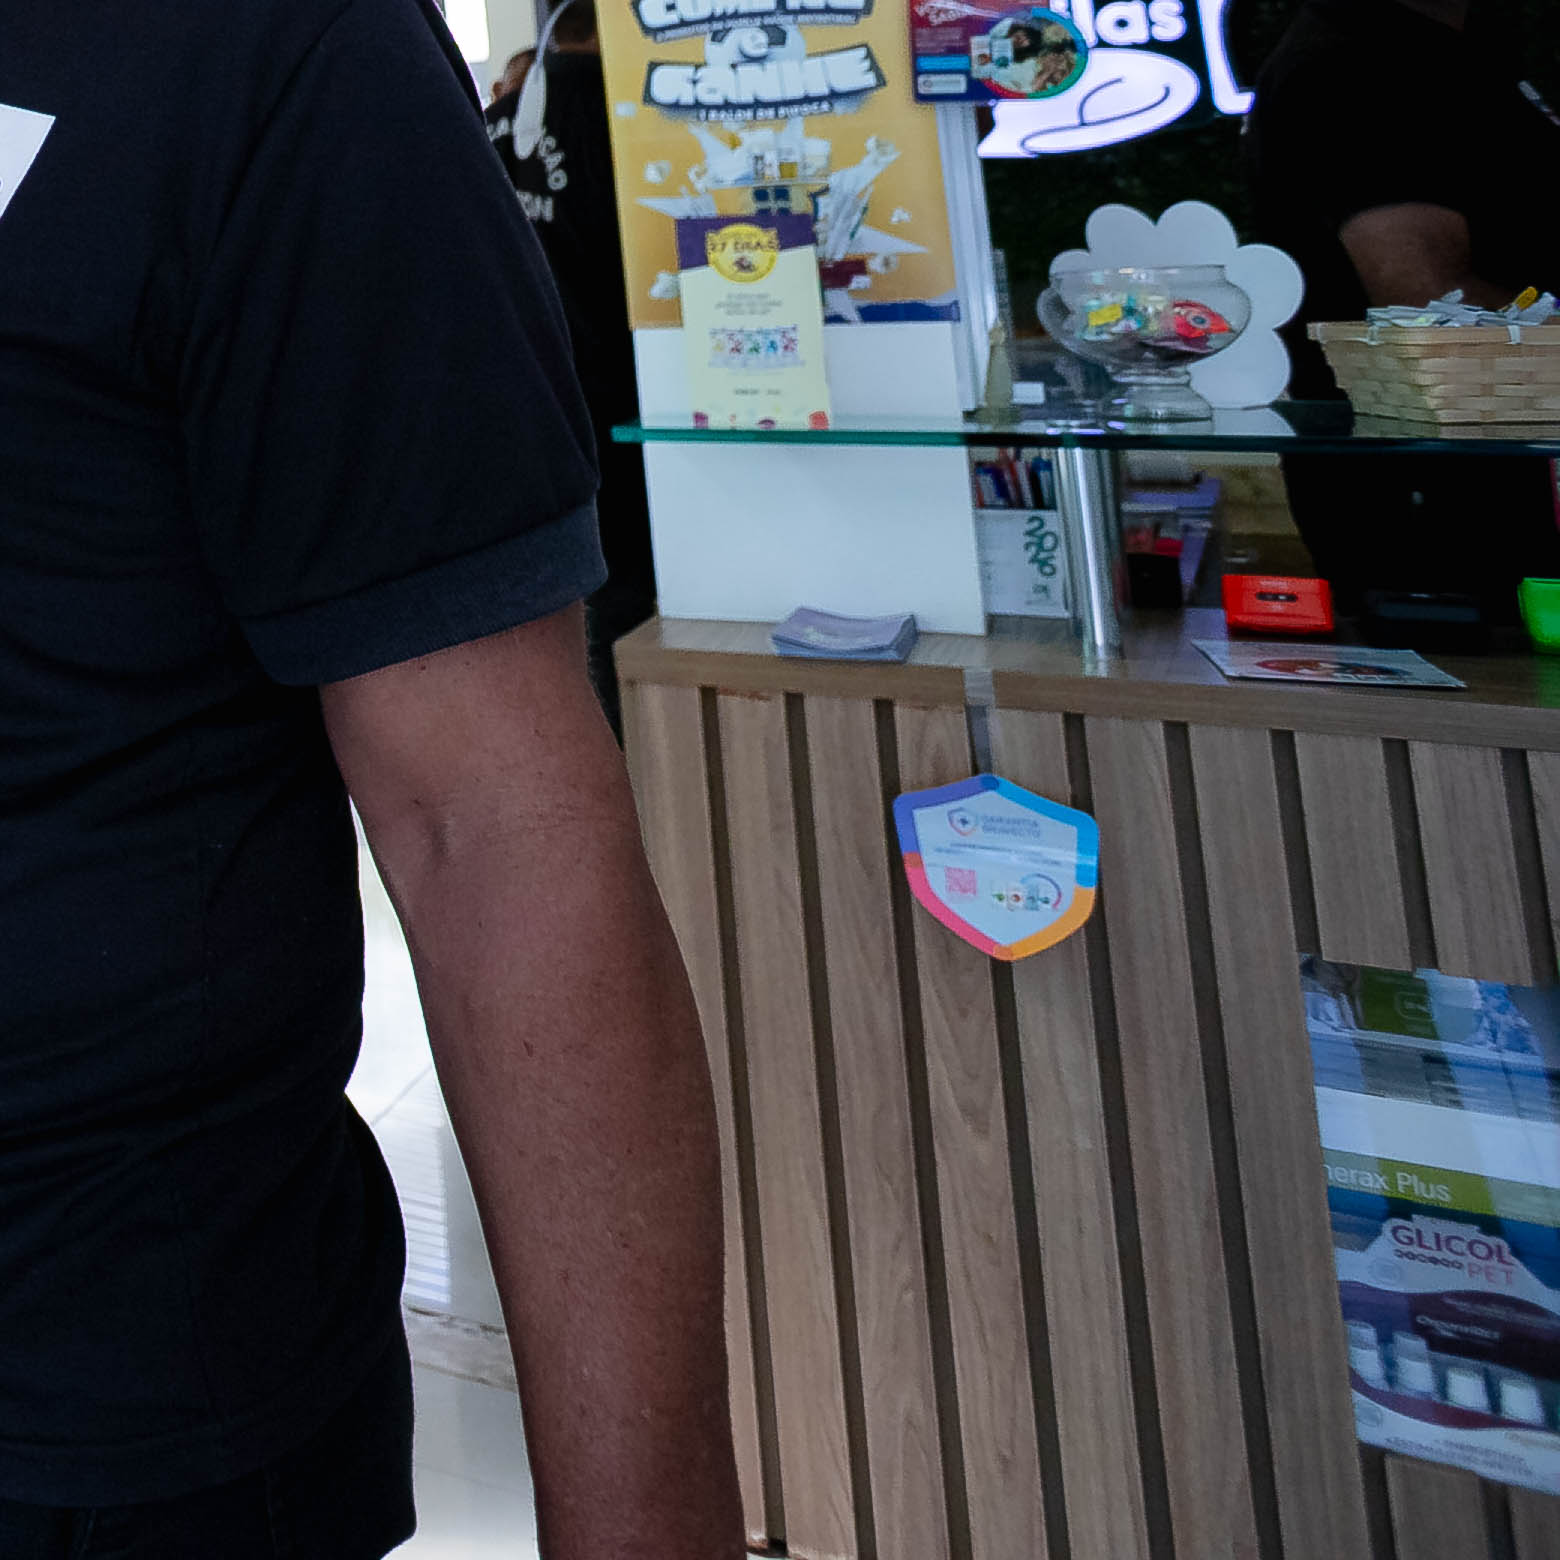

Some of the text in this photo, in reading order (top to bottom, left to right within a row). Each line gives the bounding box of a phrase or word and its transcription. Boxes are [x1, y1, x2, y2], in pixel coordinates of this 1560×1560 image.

[1396, 1173, 1452, 1203] Plus
[1391, 1224, 1515, 1266] GLICOL
[1468, 1265, 1515, 1286] PET
